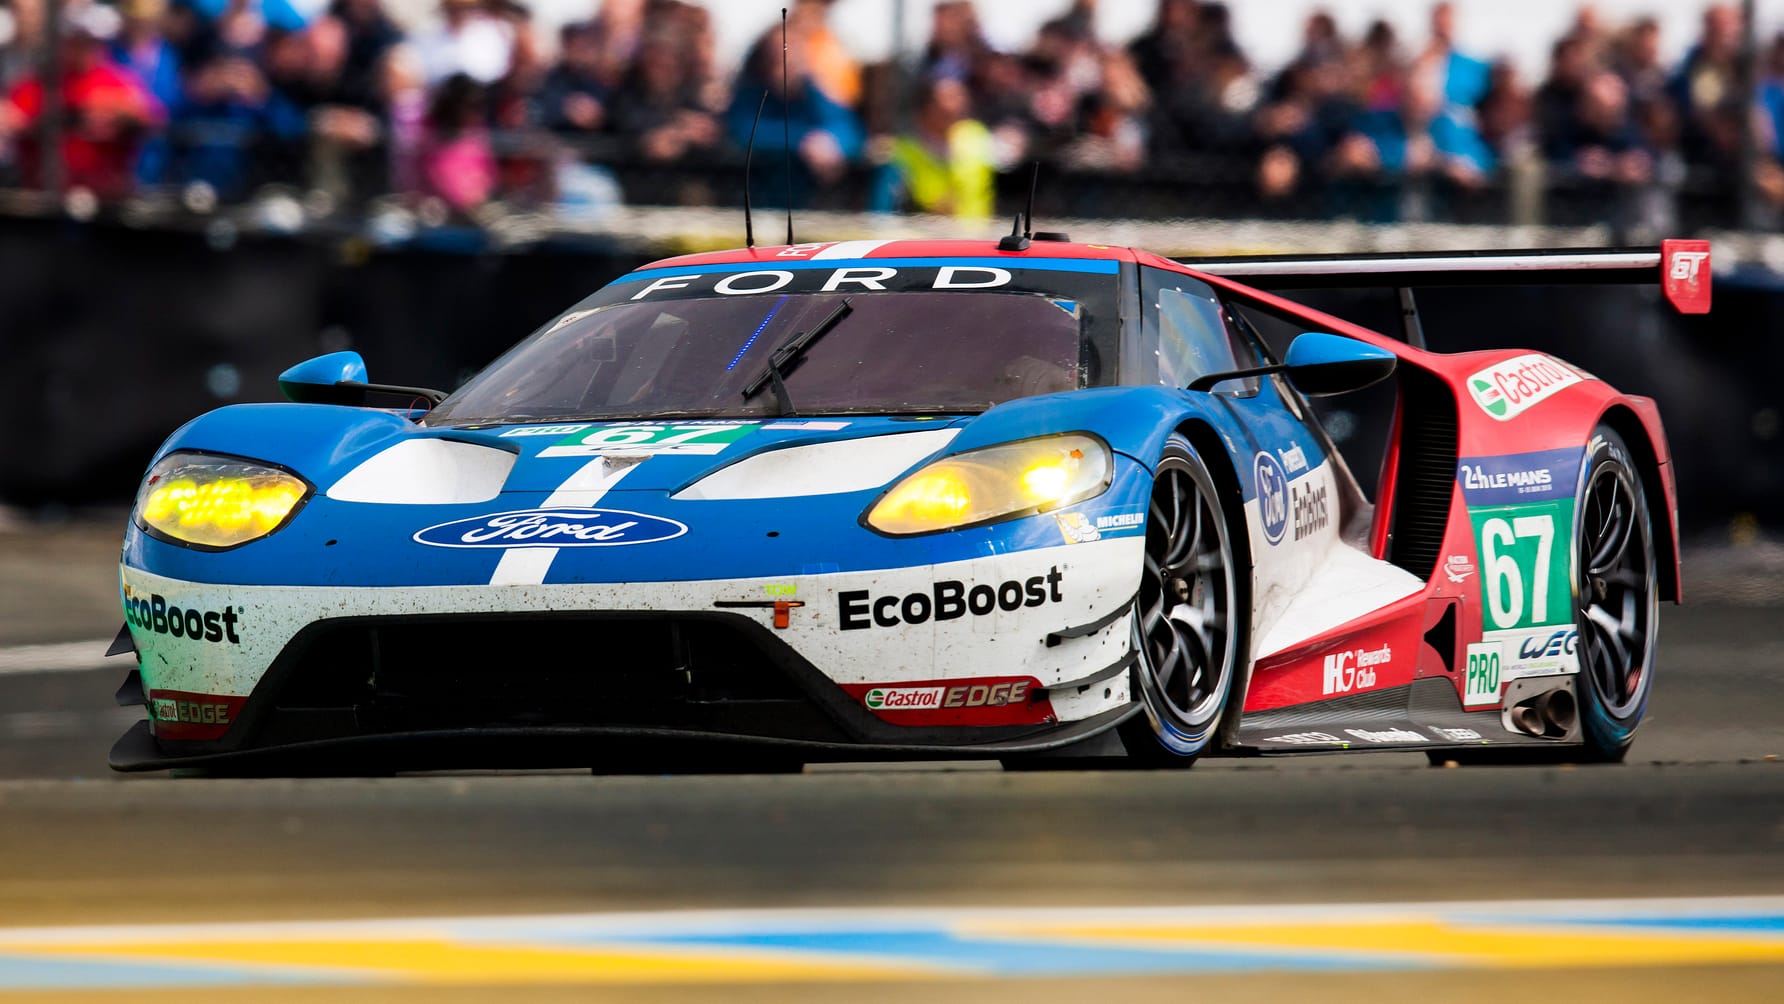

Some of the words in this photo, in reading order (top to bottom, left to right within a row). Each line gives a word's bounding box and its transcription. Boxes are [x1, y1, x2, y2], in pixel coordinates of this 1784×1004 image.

[631, 267, 1012, 300] FORD
[1670, 251, 1709, 286] GT
[1493, 359, 1571, 404] Castrol
[508, 425, 582, 436] PRO
[580, 424, 744, 446] 67
[1488, 473, 1508, 488] LE
[1507, 469, 1552, 487] MANS
[461, 513, 639, 543] Ford
[1096, 512, 1144, 528] MICHELIN
[1482, 514, 1555, 629] 67
[764, 582, 797, 597] TOW
[838, 565, 1063, 631] EcoBoost
[124, 593, 240, 644] EcoBoost
[1519, 630, 1579, 660] WEC
[1356, 666, 1377, 689] Club
[1467, 651, 1500, 696] PRO
[885, 689, 939, 707] Castrol
[944, 680, 1032, 708] EDGE
[178, 701, 230, 724] EDGE
